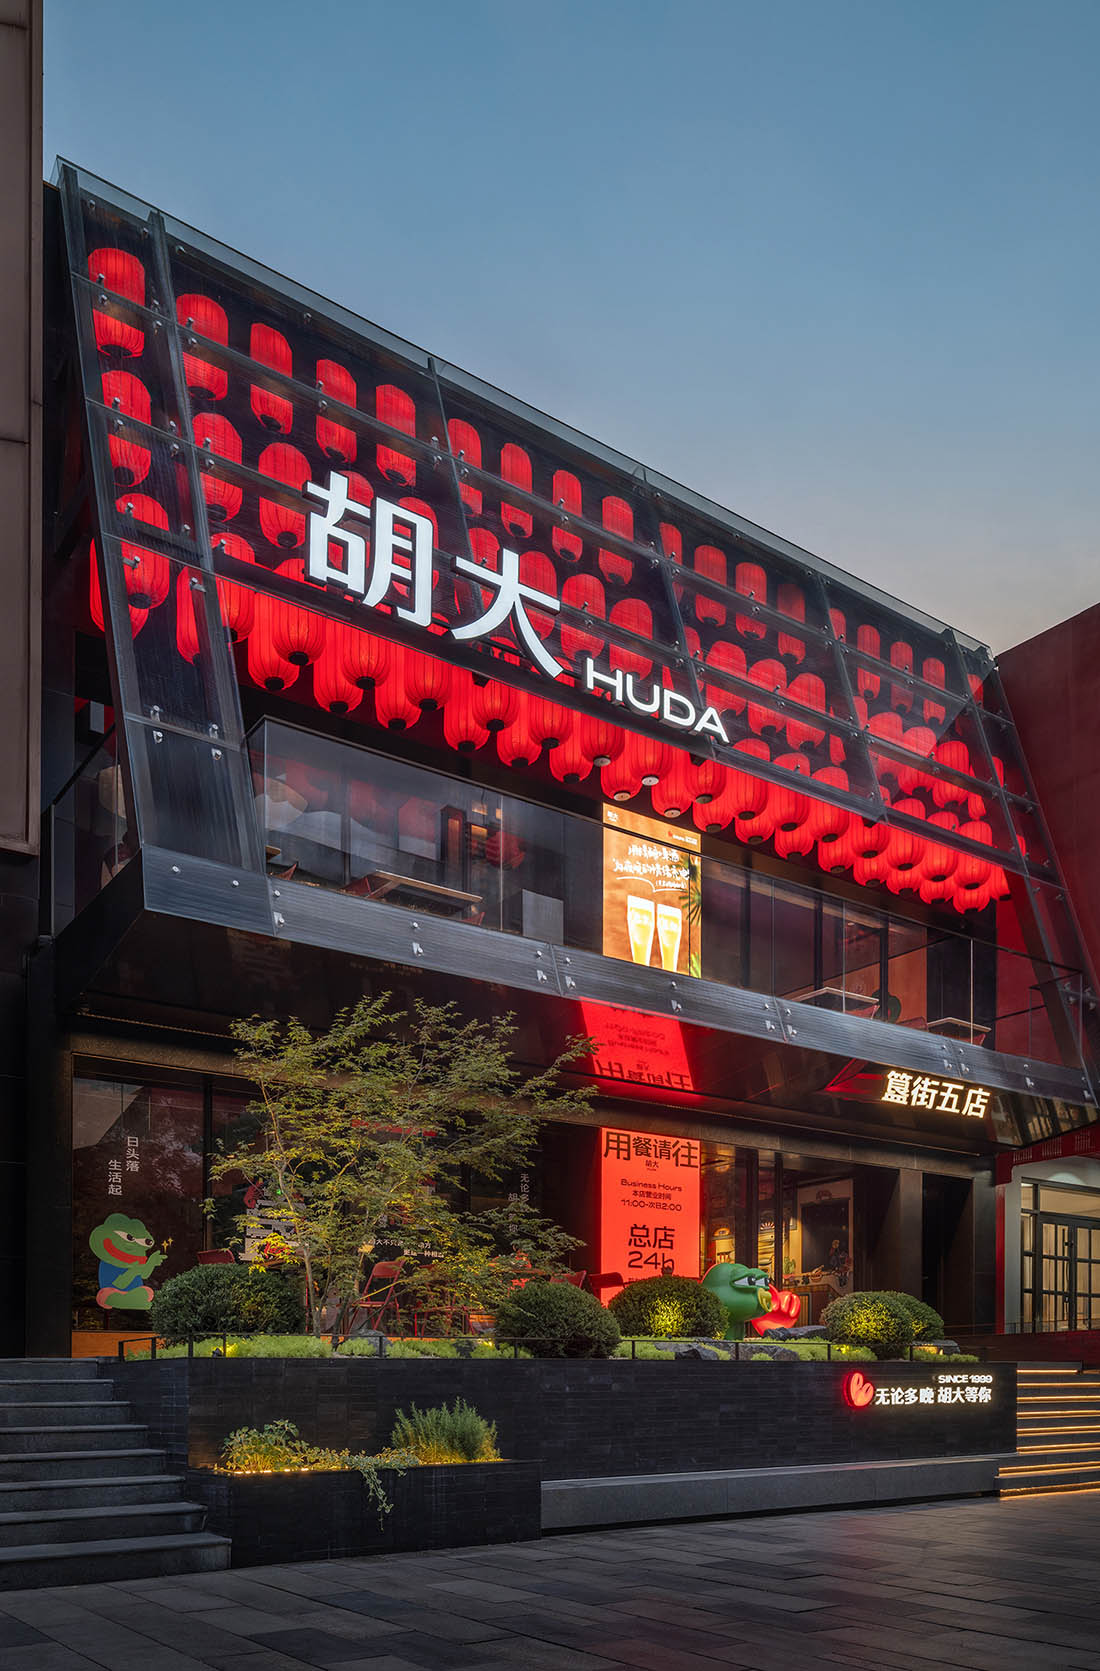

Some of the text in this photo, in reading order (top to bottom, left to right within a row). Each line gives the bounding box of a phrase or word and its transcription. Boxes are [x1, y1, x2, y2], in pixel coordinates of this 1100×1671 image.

[303, 471, 564, 679] 胡大
[585, 657, 730, 743] HUDA
[881, 1070, 991, 1118] 簋街五店
[126, 1136, 140, 1172] 日头落
[604, 1131, 699, 1168] 用餐请往
[108, 1160, 122, 1195] 生活起
[621, 1178, 682, 1192] Business Hours
[621, 1199, 682, 1211] 11:00-次日2:00
[632, 1190, 672, 1200] 本店营业时间
[628, 1223, 675, 1249] 总店
[628, 1251, 675, 1275] 24h
[938, 1374, 993, 1384] SINCE 1999
[875, 1386, 992, 1405] 无论多晚 胡大等你
